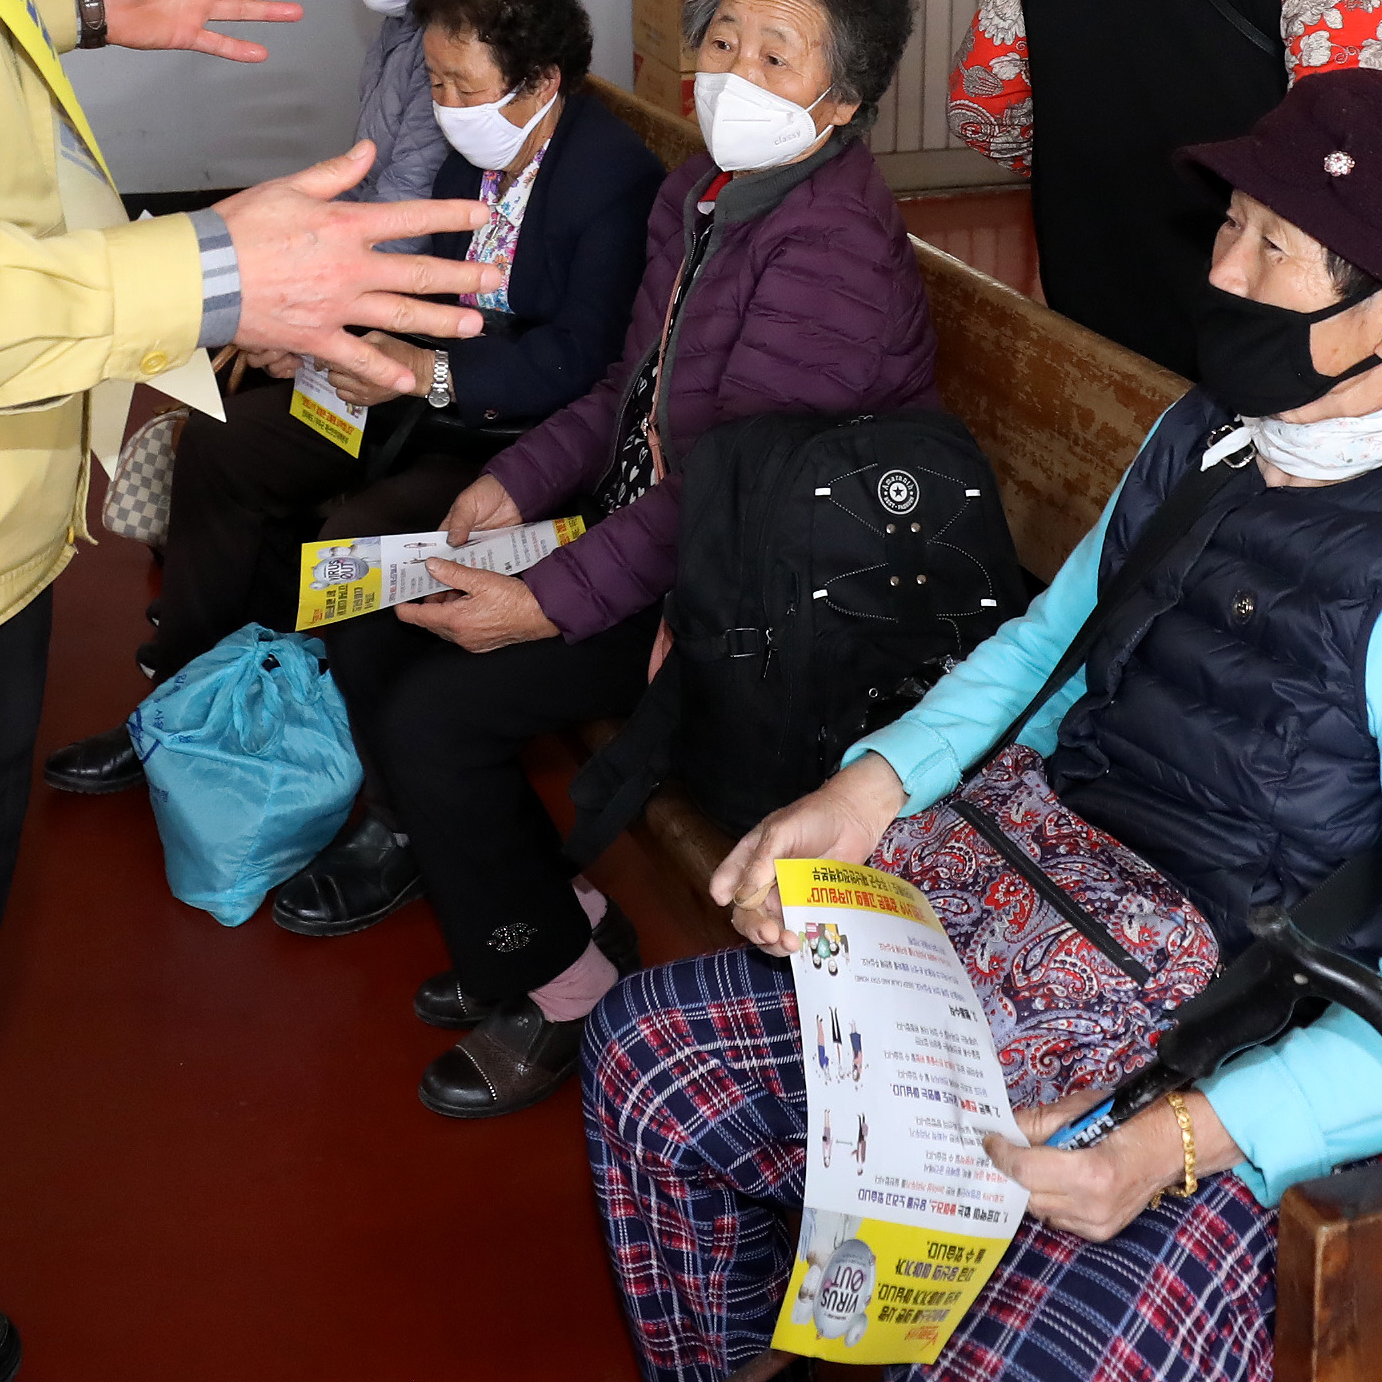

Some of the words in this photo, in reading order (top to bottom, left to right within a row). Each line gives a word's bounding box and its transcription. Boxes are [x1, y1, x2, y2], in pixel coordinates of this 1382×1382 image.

[328, 560, 340, 582] VIRUS
[884, 1192, 905, 1207] 노리고
[926, 1241, 964, 1262] 있습니다.
[965, 1248, 975, 1262] 수
[830, 1265, 863, 1293] OUT
[895, 1259, 931, 1279] 이야기가
[931, 1264, 958, 1281] 당신의
[820, 1289, 858, 1312] VIRUS
